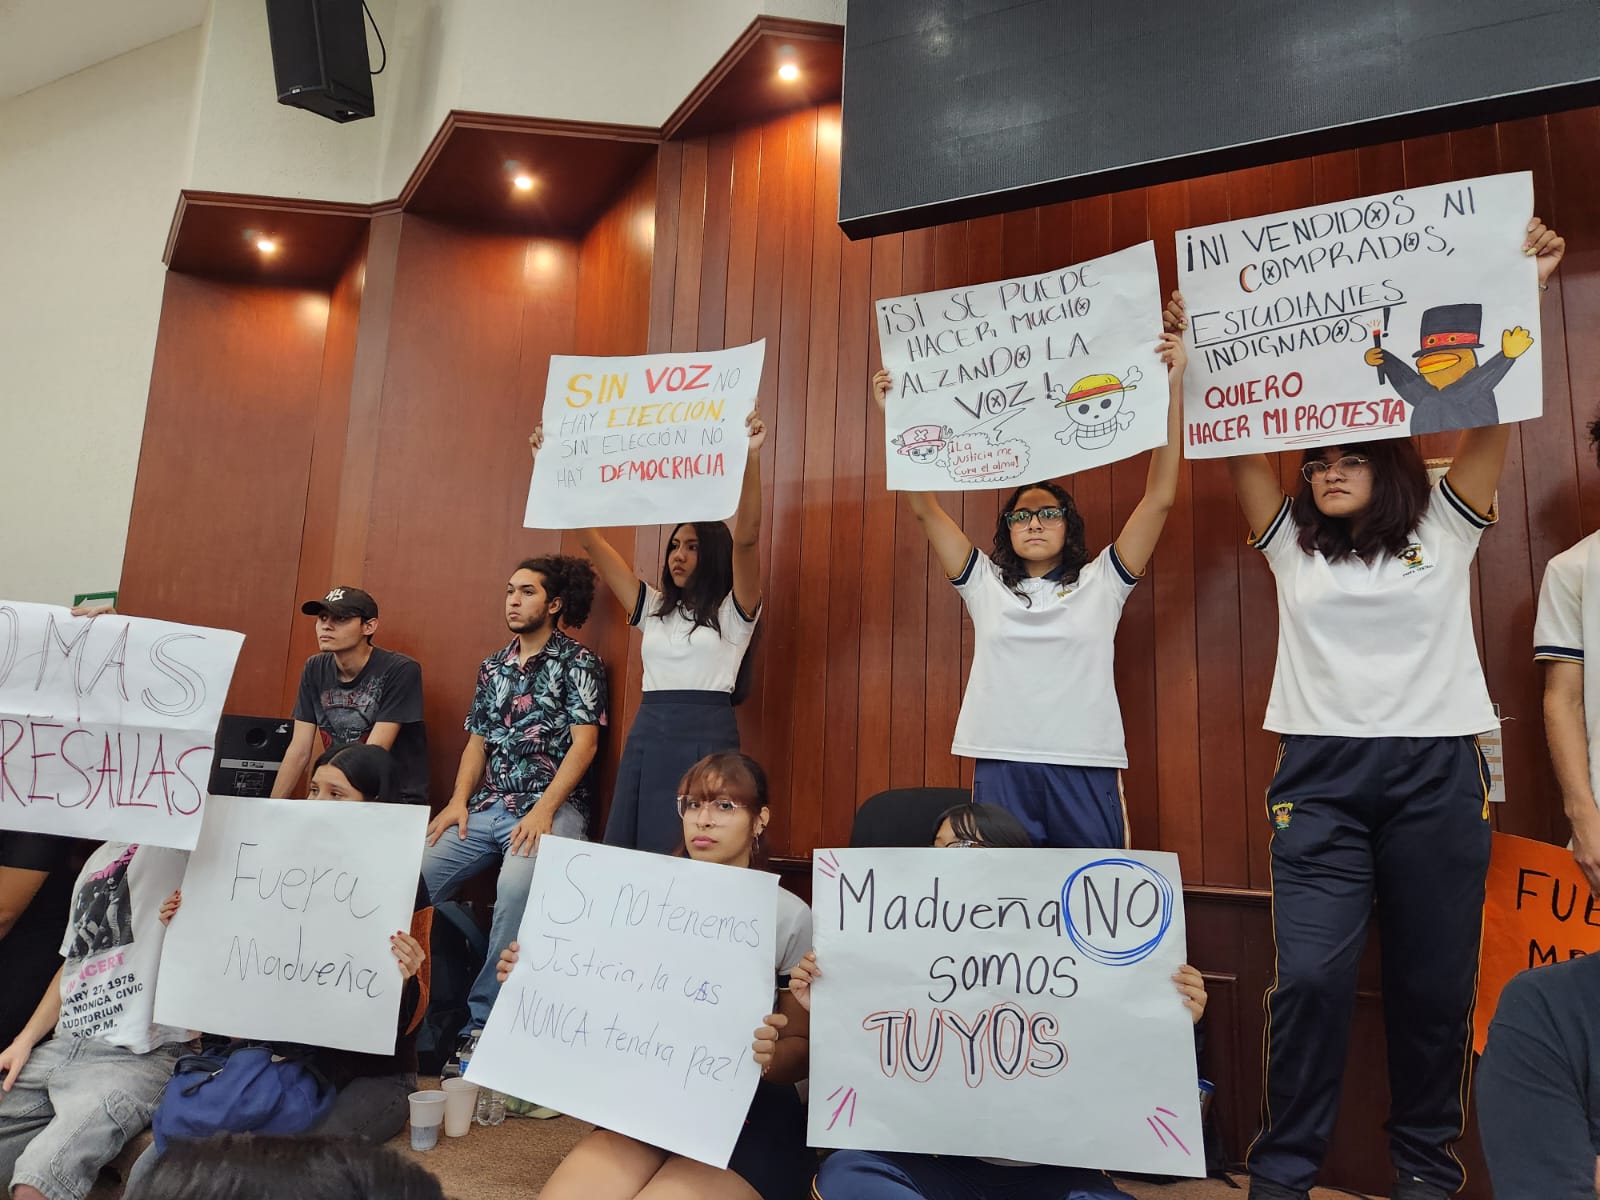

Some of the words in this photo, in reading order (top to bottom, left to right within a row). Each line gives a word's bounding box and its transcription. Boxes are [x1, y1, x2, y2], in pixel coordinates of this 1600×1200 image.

[1442, 186, 1476, 219] NI
[943, 290, 988, 322] SE
[999, 264, 1101, 311] PUEDE
[1190, 278, 1405, 345] ESTUDIANTES
[1046, 331, 1091, 361] LA
[565, 372, 629, 408] SIN
[645, 364, 713, 394] VOZ
[712, 367, 741, 393] NO
[1203, 371, 1304, 410] QUIERO
[559, 410, 599, 437] HAY
[1188, 414, 1251, 447] HACER
[1263, 408, 1289, 436] MI
[1295, 398, 1407, 432] PROTESTA
[560, 438, 590, 459] SIN
[701, 427, 724, 447] NO
[996, 447, 1012, 457] me
[556, 465, 584, 489] HAY
[599, 452, 725, 484] DEMOCRACIA
[981, 463, 989, 473] el
[230, 842, 381, 919] Fuera
[611, 882, 651, 927] no
[657, 875, 761, 948] tenemos
[1083, 875, 1160, 938] NO
[107, 973, 136, 990] 1978
[650, 962, 667, 993] la
[62, 1003, 124, 1029] AUDITORIUM
[73, 995, 112, 1014] MONICA
[116, 983, 144, 1000] CIVIC
[510, 985, 591, 1048] NUNCA
[863, 1002, 1068, 1088] TUYOS
